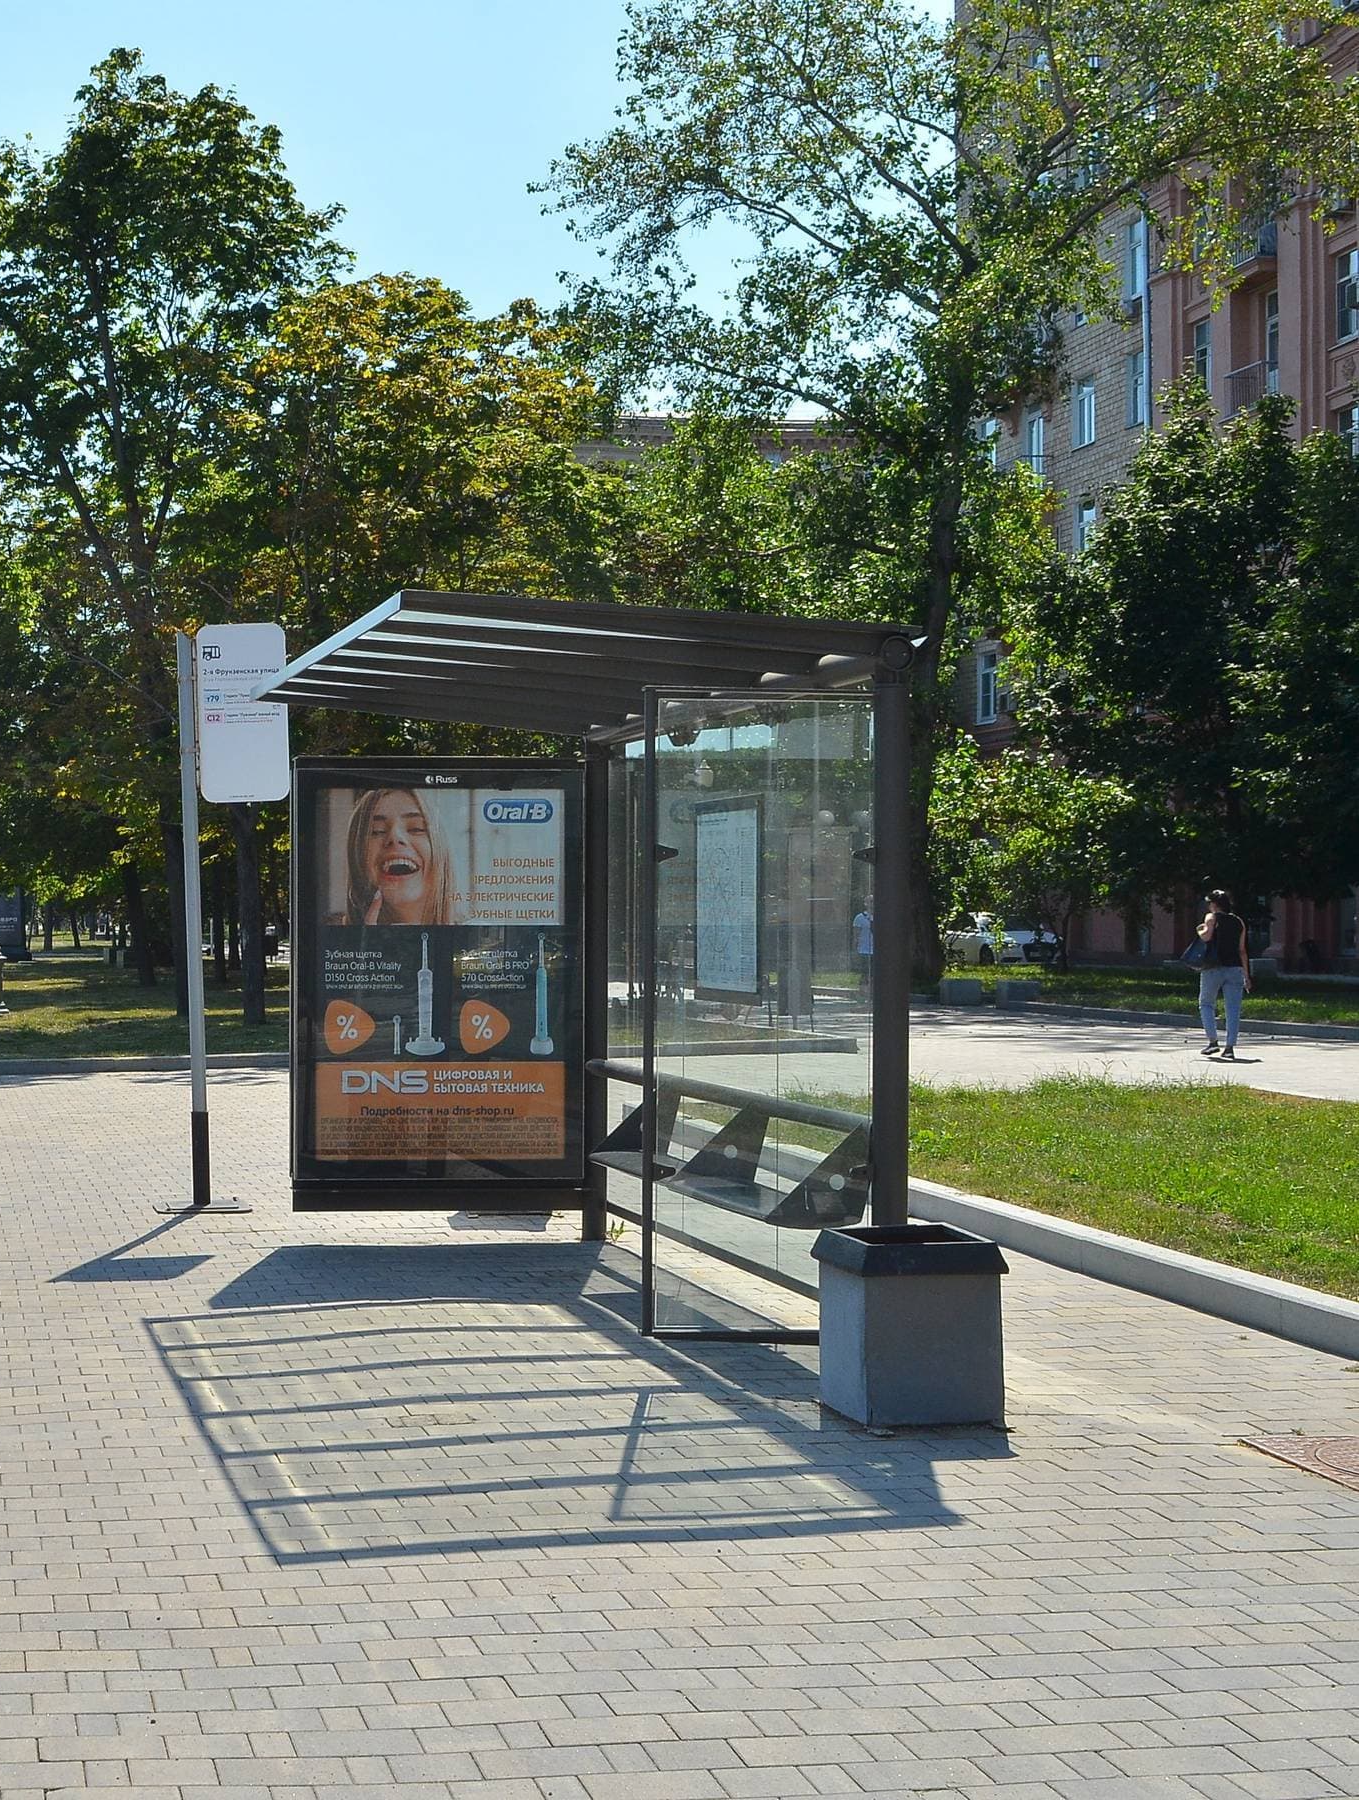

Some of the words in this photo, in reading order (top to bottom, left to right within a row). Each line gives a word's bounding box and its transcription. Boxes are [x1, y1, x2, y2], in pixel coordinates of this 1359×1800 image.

[215, 668, 258, 676] Фрунзенская
[260, 667, 280, 675] улица
[435, 775, 458, 784] Russ
[486, 802, 548, 821] Oral-B
[492, 858, 555, 869] ВЫГОДНЫЕ
[448, 892, 462, 902] НА
[466, 892, 555, 902] ЭЛЕКТРИЧЕСКИЕ
[471, 909, 513, 919] ЗУБНЫЕ
[516, 909, 555, 920] ЩЕТКИ
[324, 949, 354, 960] Зубная
[355, 951, 383, 960] щетка
[324, 961, 349, 970] Braun
[350, 961, 375, 970] Oral-B
[376, 961, 402, 972] Vitality
[461, 961, 484, 970] Braun
[486, 961, 511, 970] Oral-B
[512, 961, 530, 970] PRO
[324, 973, 345, 982] D150
[346, 973, 369, 982] Cross
[371, 973, 396, 982] Action
[461, 973, 476, 982] 570
[478, 973, 525, 982] CrossAction
[433, 1070, 500, 1082] ЦИФРОВАЯ
[502, 1070, 513, 1080] И
[342, 1070, 429, 1094] DNS
[433, 1083, 488, 1094] БЫТОВАЯ
[491, 1083, 545, 1093] ТЕХНИКА
[360, 1106, 433, 1118] Подробности
[436, 1108, 449, 1116] на
[452, 1105, 515, 1118] dns-shop.ru
